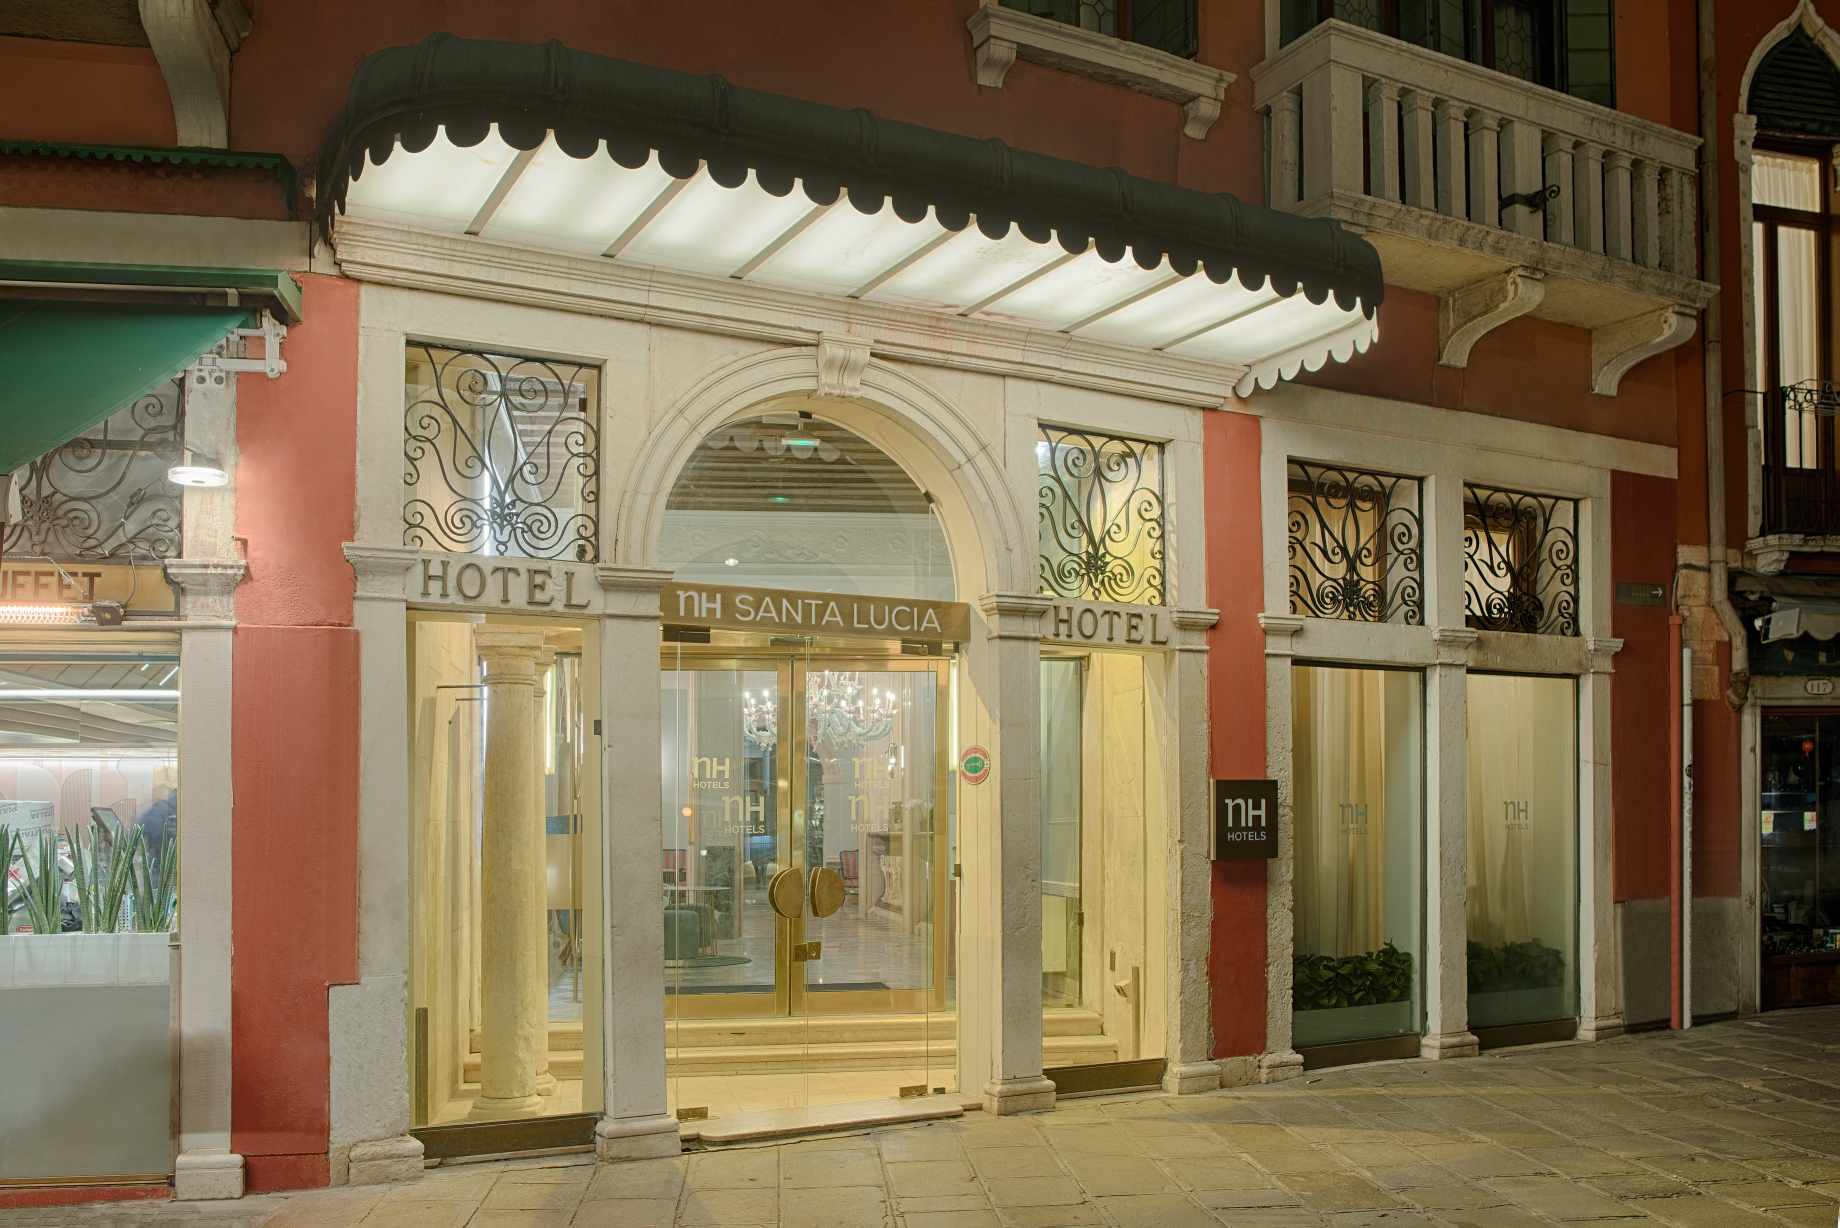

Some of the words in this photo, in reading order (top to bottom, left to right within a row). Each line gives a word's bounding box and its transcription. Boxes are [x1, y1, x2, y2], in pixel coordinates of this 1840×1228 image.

[420, 558, 591, 609] HOTEL
[735, 594, 844, 627] SANTA
[853, 602, 942, 633] LUCIA
[1053, 605, 1169, 645] HOTEL
[1810, 681, 1829, 693] 117
[693, 781, 730, 789] HOTELS
[854, 781, 890, 789] HOTELS
[724, 825, 765, 834] HOTELS
[850, 823, 889, 832] HOTELS
[1504, 822, 1529, 831] HOTELS
[1341, 827, 1369, 836] HOTELS
[1227, 831, 1267, 842] HOTELS
